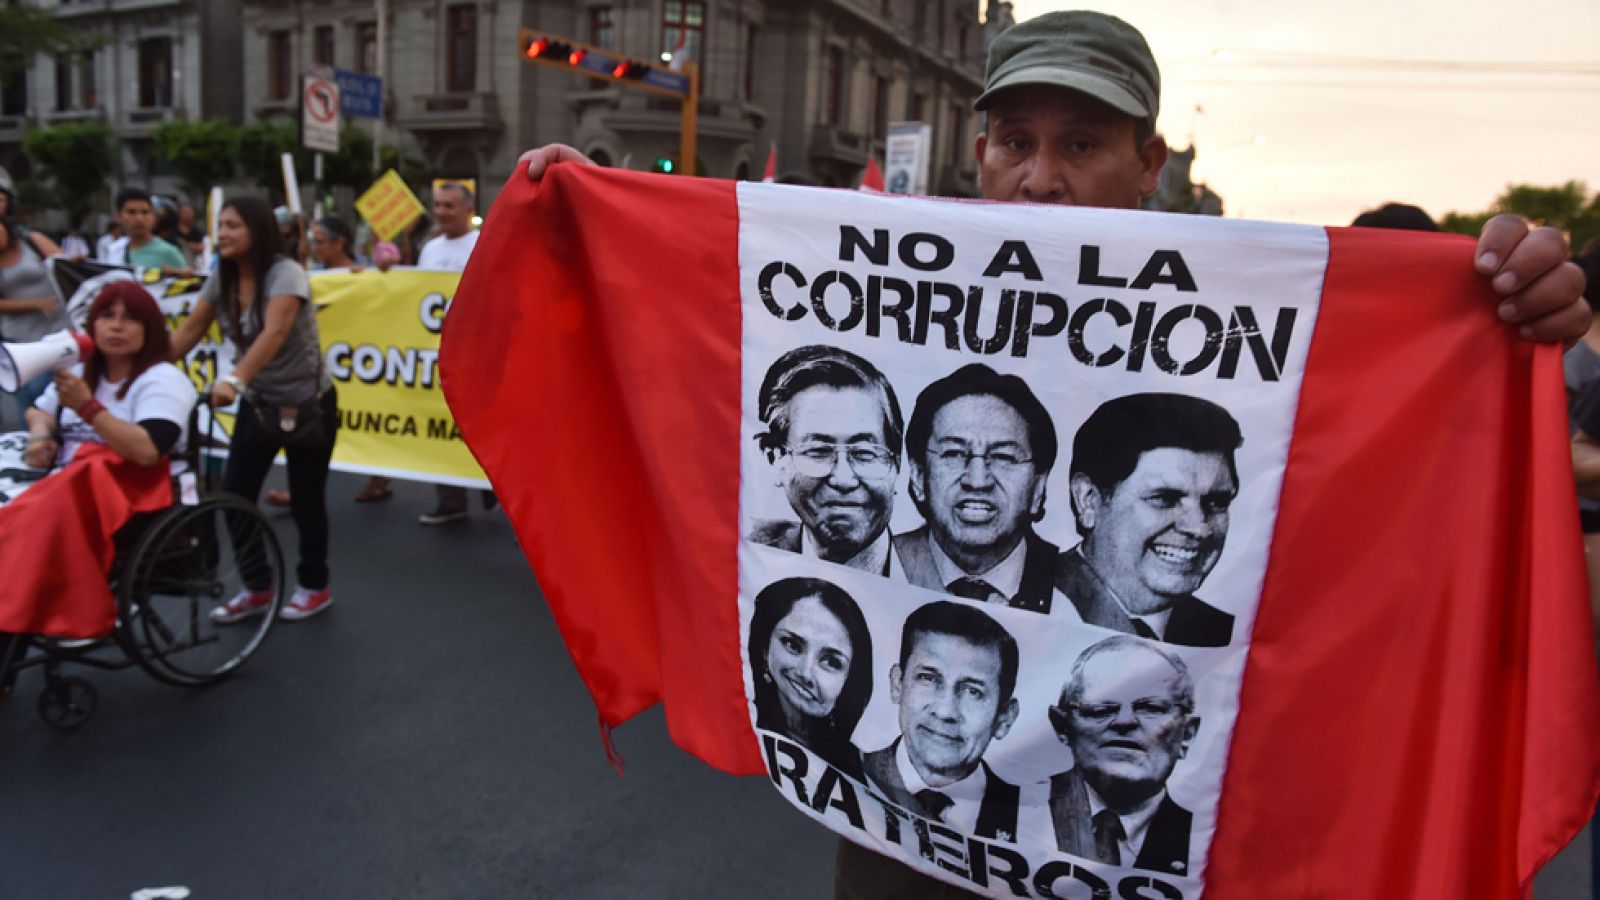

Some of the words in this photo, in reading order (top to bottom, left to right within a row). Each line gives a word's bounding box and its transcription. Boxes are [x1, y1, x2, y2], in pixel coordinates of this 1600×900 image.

[838, 225, 955, 271] NO
[983, 239, 1044, 282] A
[1078, 245, 1199, 292] LA
[419, 292, 453, 334] C
[758, 261, 1298, 382] CORRUPCION
[325, 341, 441, 390] CONT
[763, 735, 1184, 900] RATEROS
